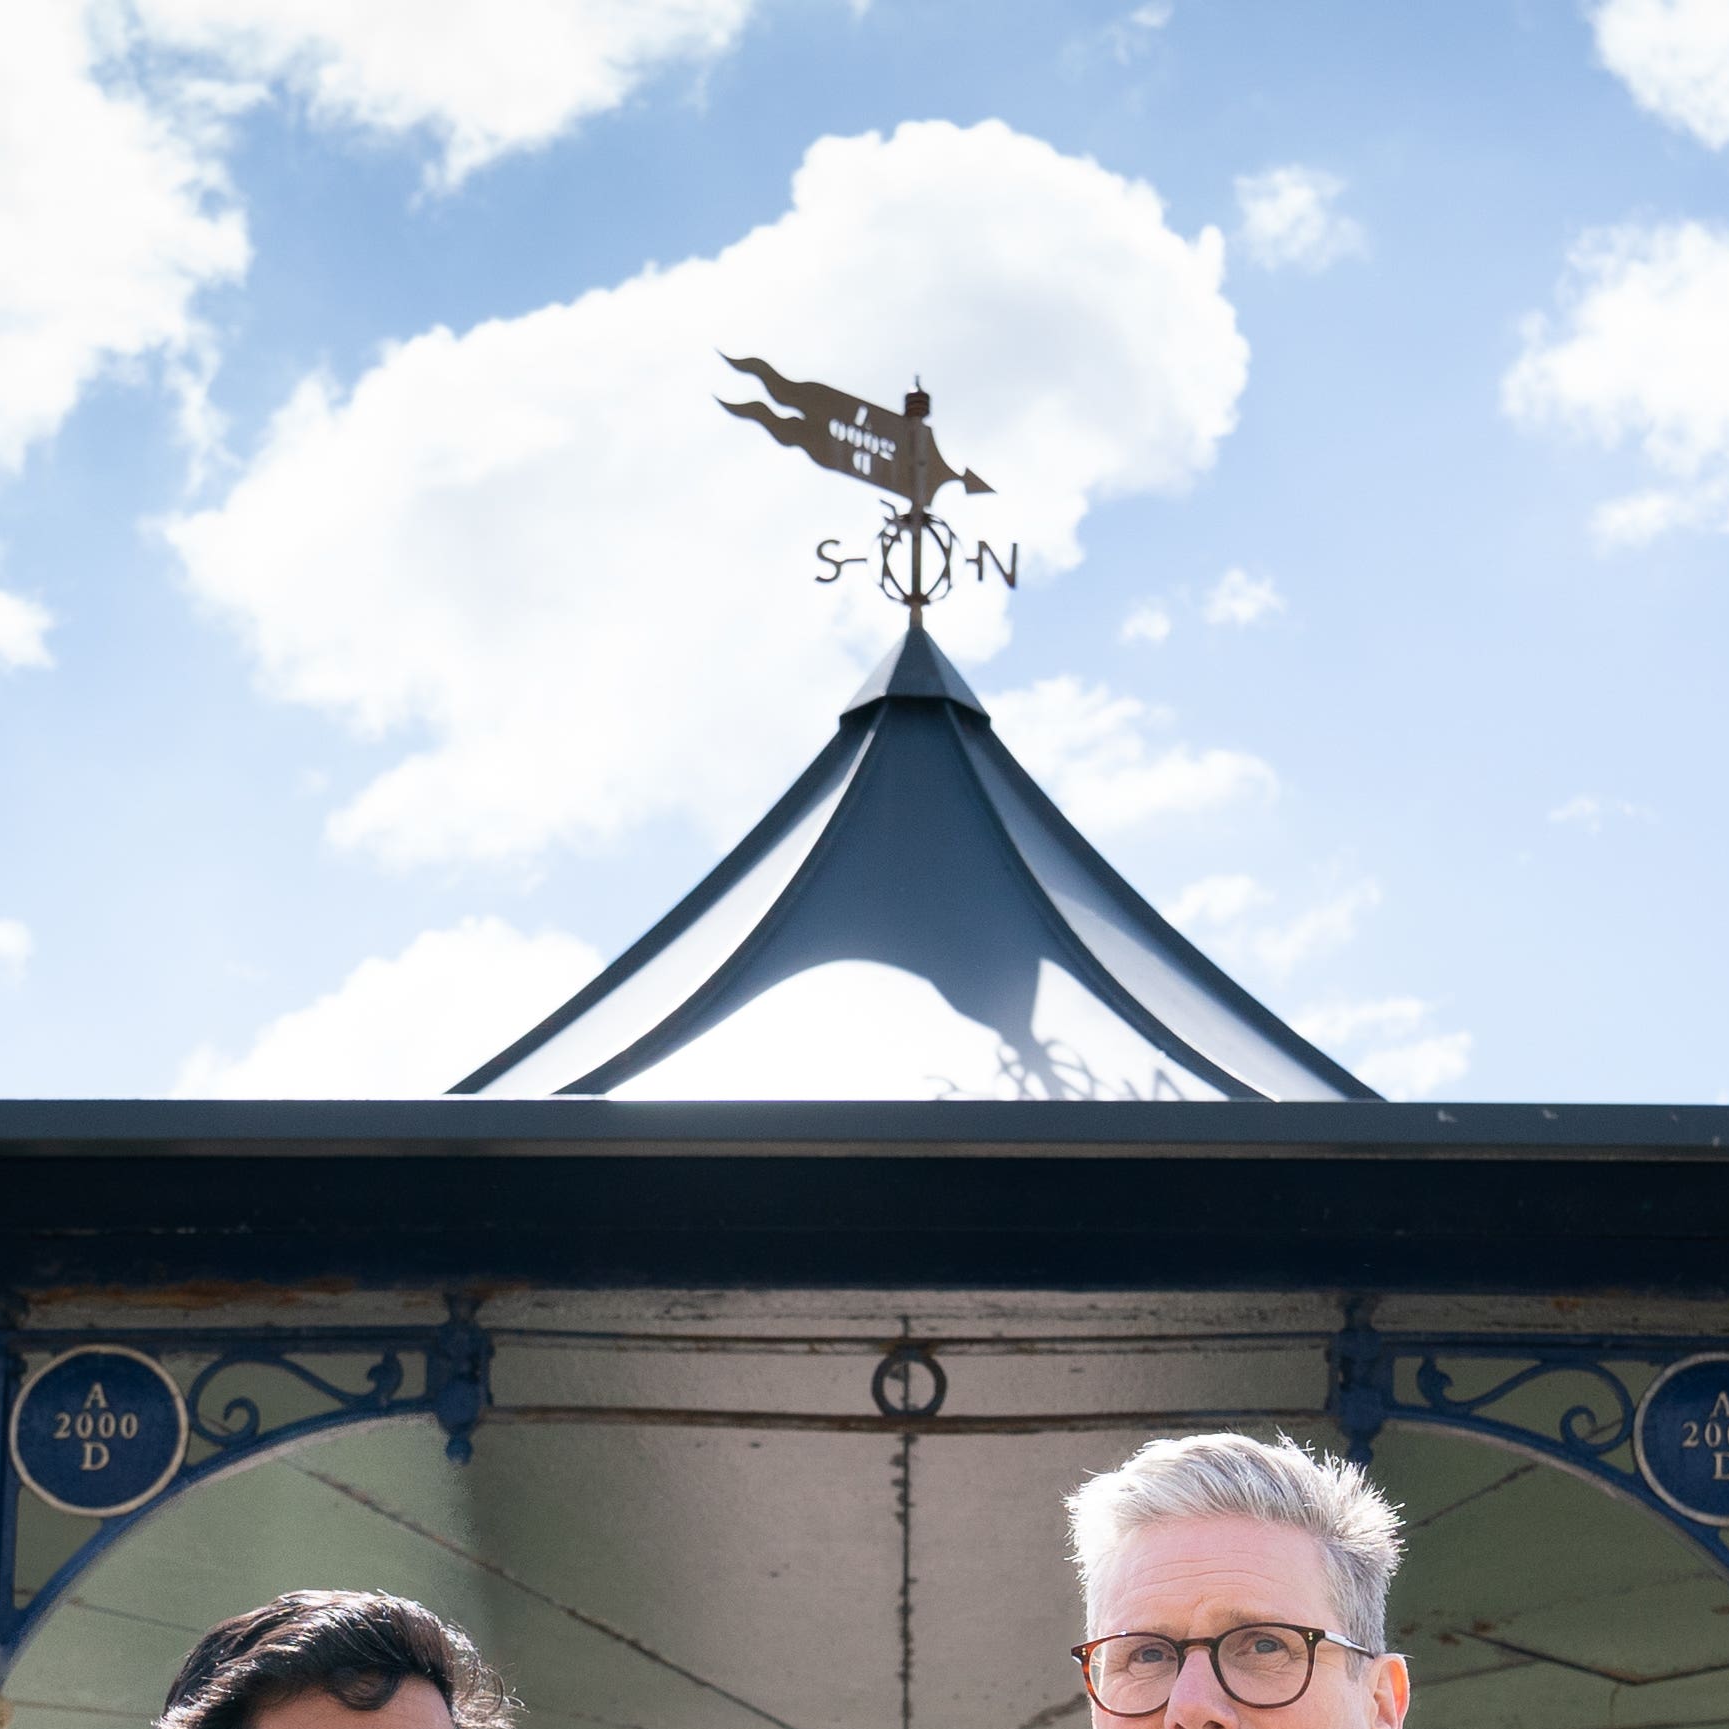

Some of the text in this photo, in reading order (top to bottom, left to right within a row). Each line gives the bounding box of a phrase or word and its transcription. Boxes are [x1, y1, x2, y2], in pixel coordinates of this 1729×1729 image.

[814, 538, 1018, 589] S N
[83, 1381, 110, 1409] A
[53, 1412, 139, 1440] 2000
[79, 1441, 110, 1471] D
